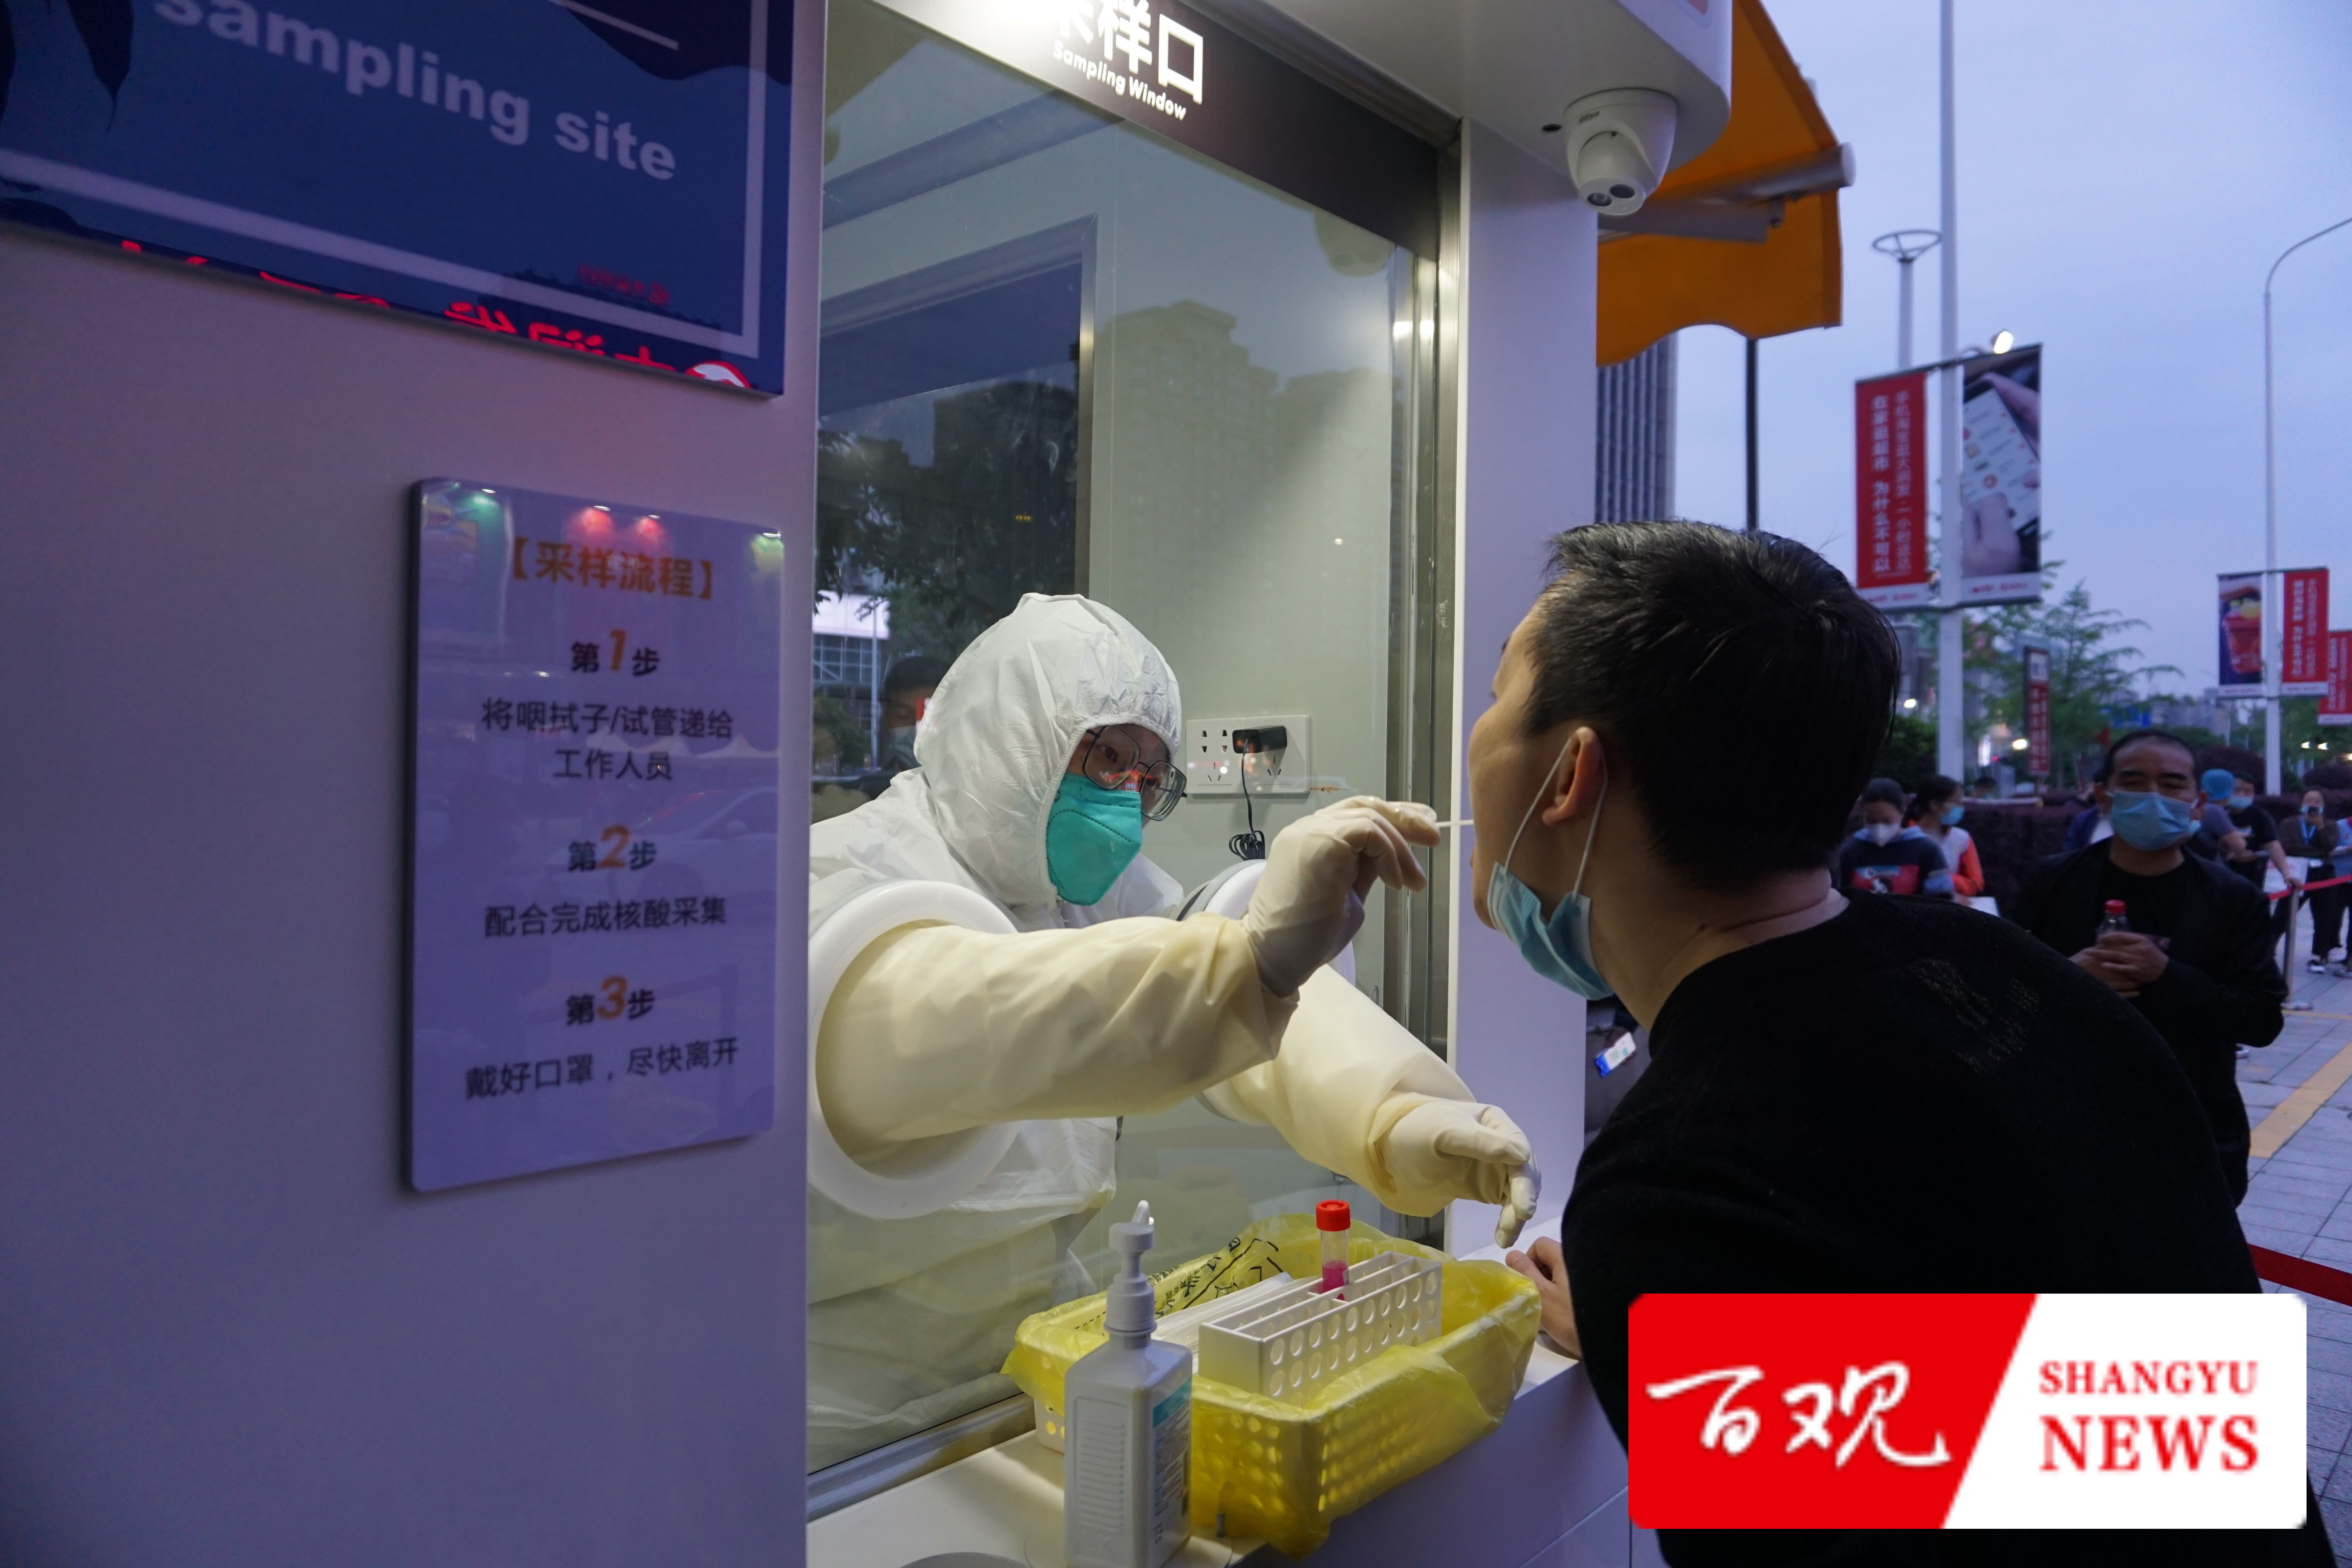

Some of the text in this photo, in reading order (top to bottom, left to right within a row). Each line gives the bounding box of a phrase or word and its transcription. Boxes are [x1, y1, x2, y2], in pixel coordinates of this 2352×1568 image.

[1053, 40, 1187, 120] Sampling Window
[554, 110, 677, 180] site
[511, 535, 713, 600] 【采样流程】
[570, 629, 661, 676] 第1步
[481, 697, 733, 739] 将咽拭子/试管递给
[553, 748, 673, 781] 工作人员
[568, 824, 657, 872] 第2步
[484, 896, 727, 938] 配合完成核酸采集
[565, 975, 655, 1027] 第3步
[465, 1036, 739, 1100] 戴好口罩，尽快离开
